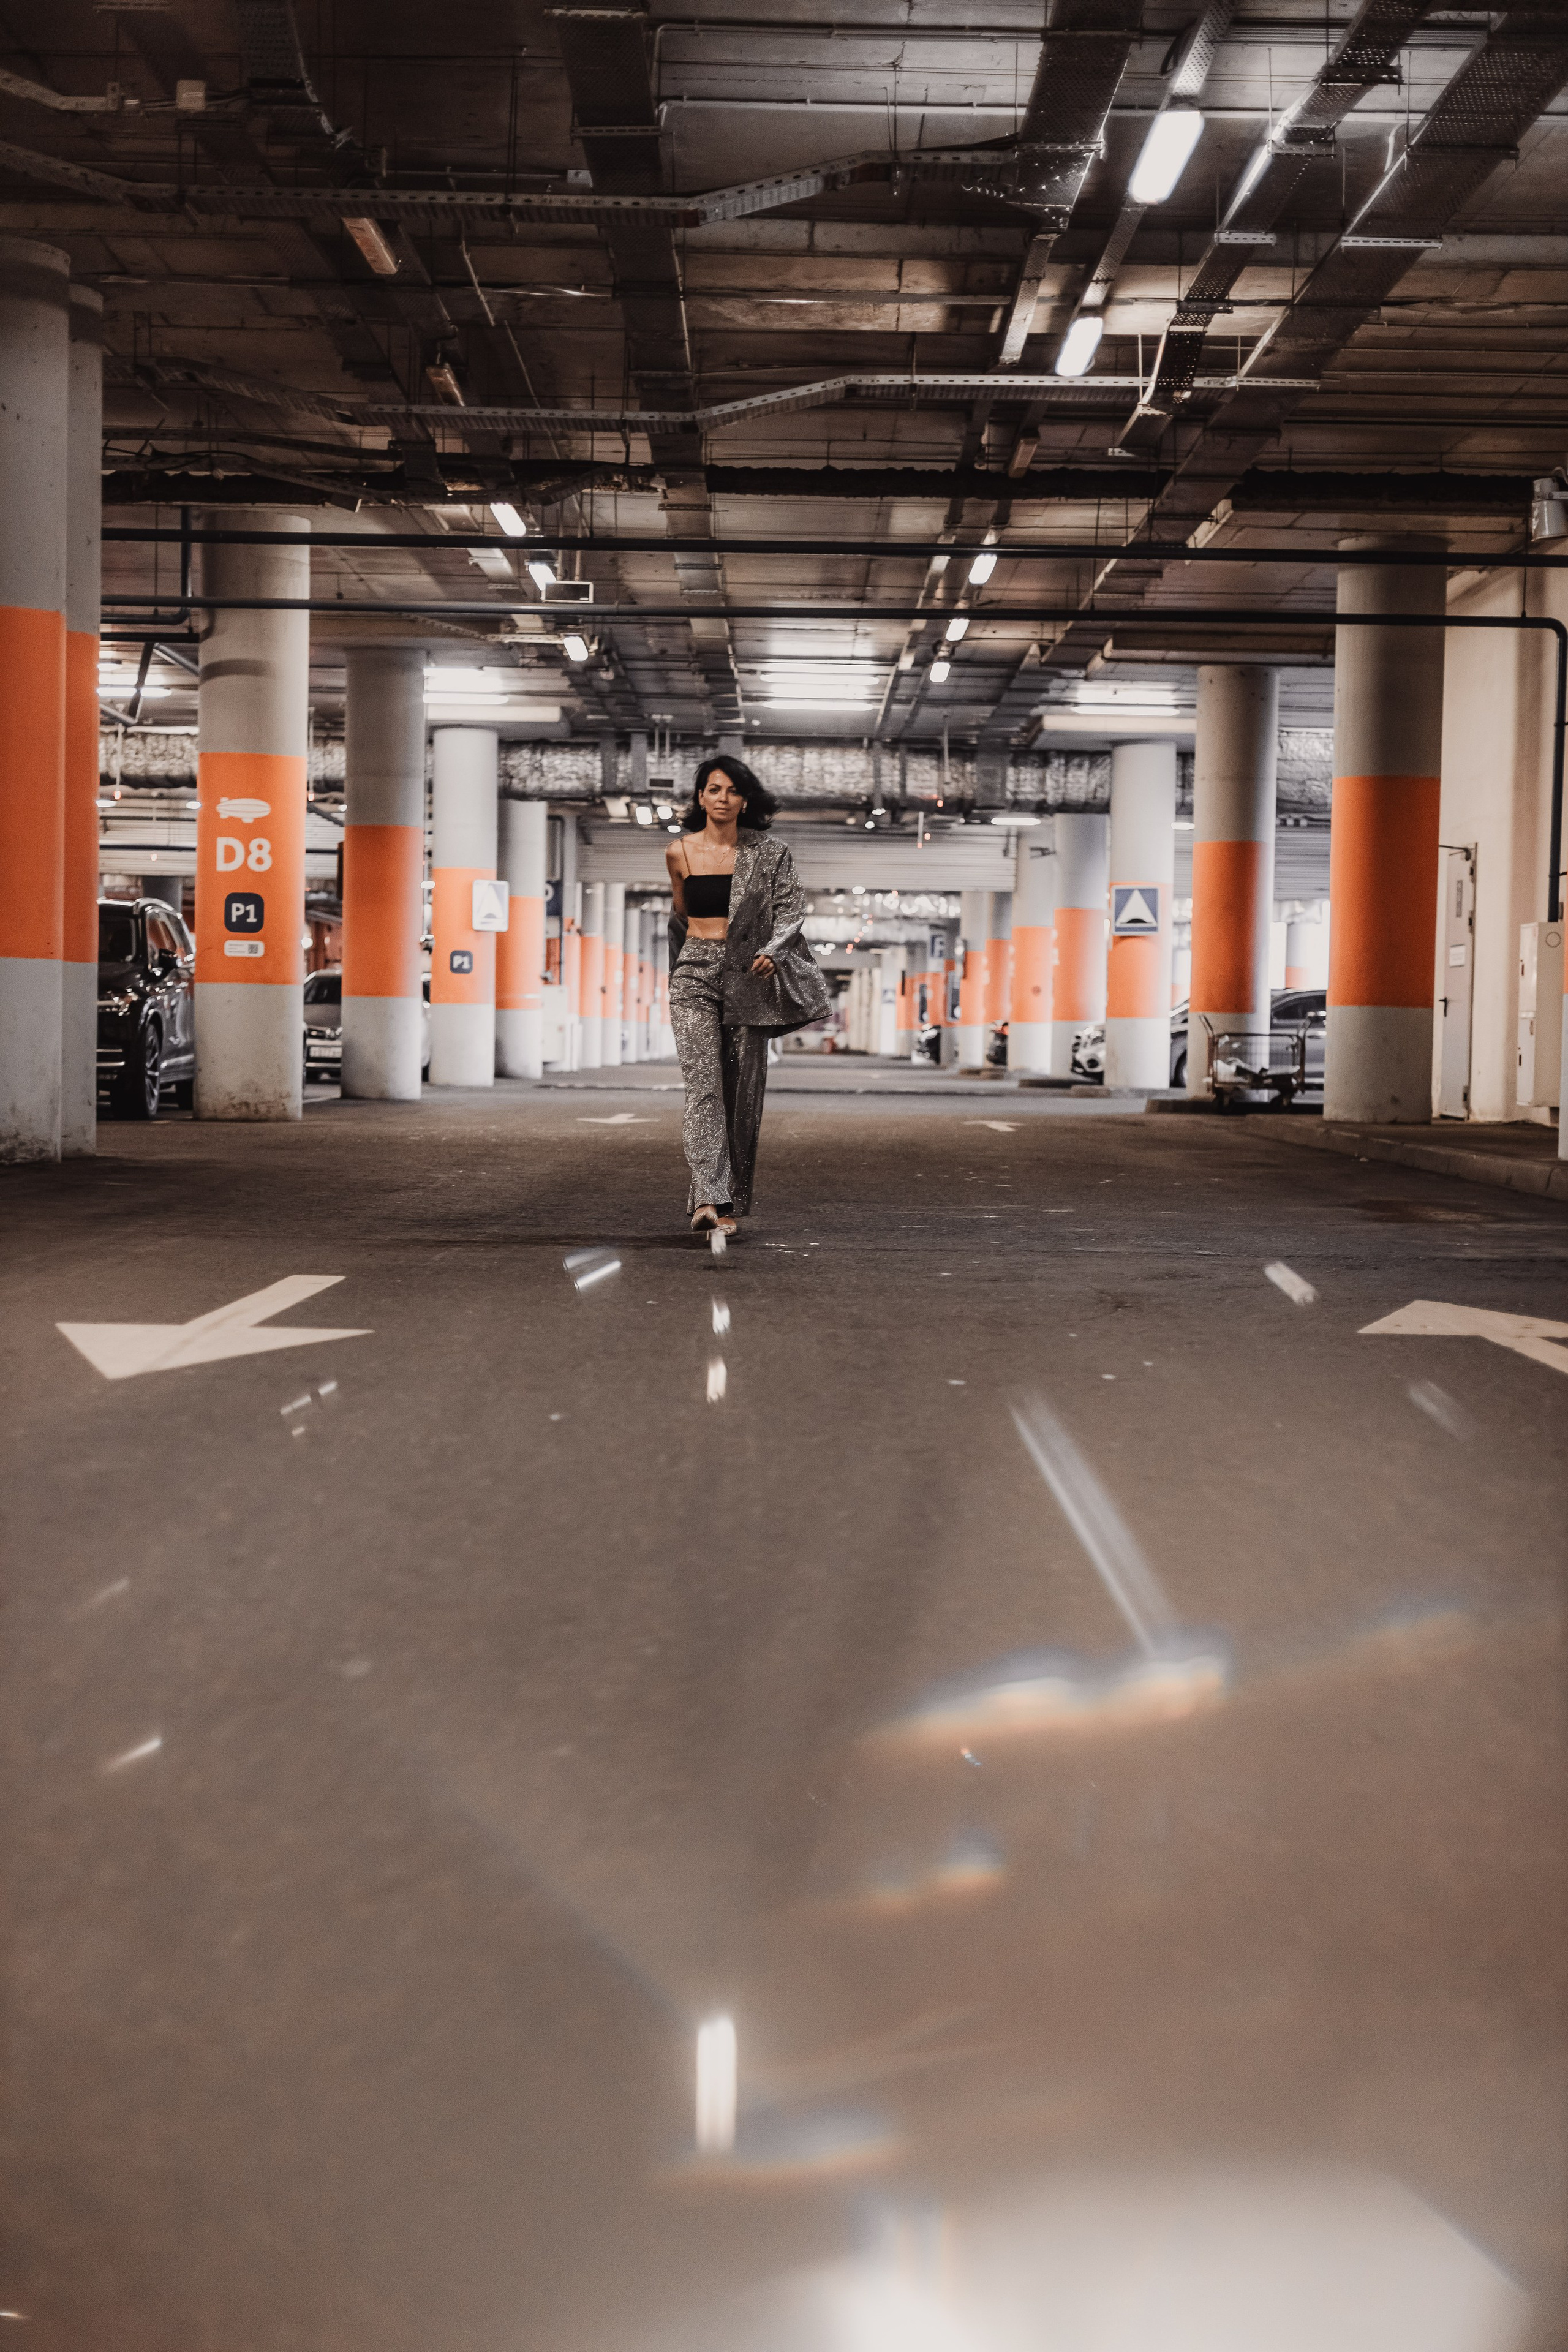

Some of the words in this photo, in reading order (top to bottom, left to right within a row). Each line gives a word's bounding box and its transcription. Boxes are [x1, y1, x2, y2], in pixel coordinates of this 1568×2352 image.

[216, 837, 273, 872] D8
[231, 903, 257, 922] P1
[453, 955, 470, 969] P1
